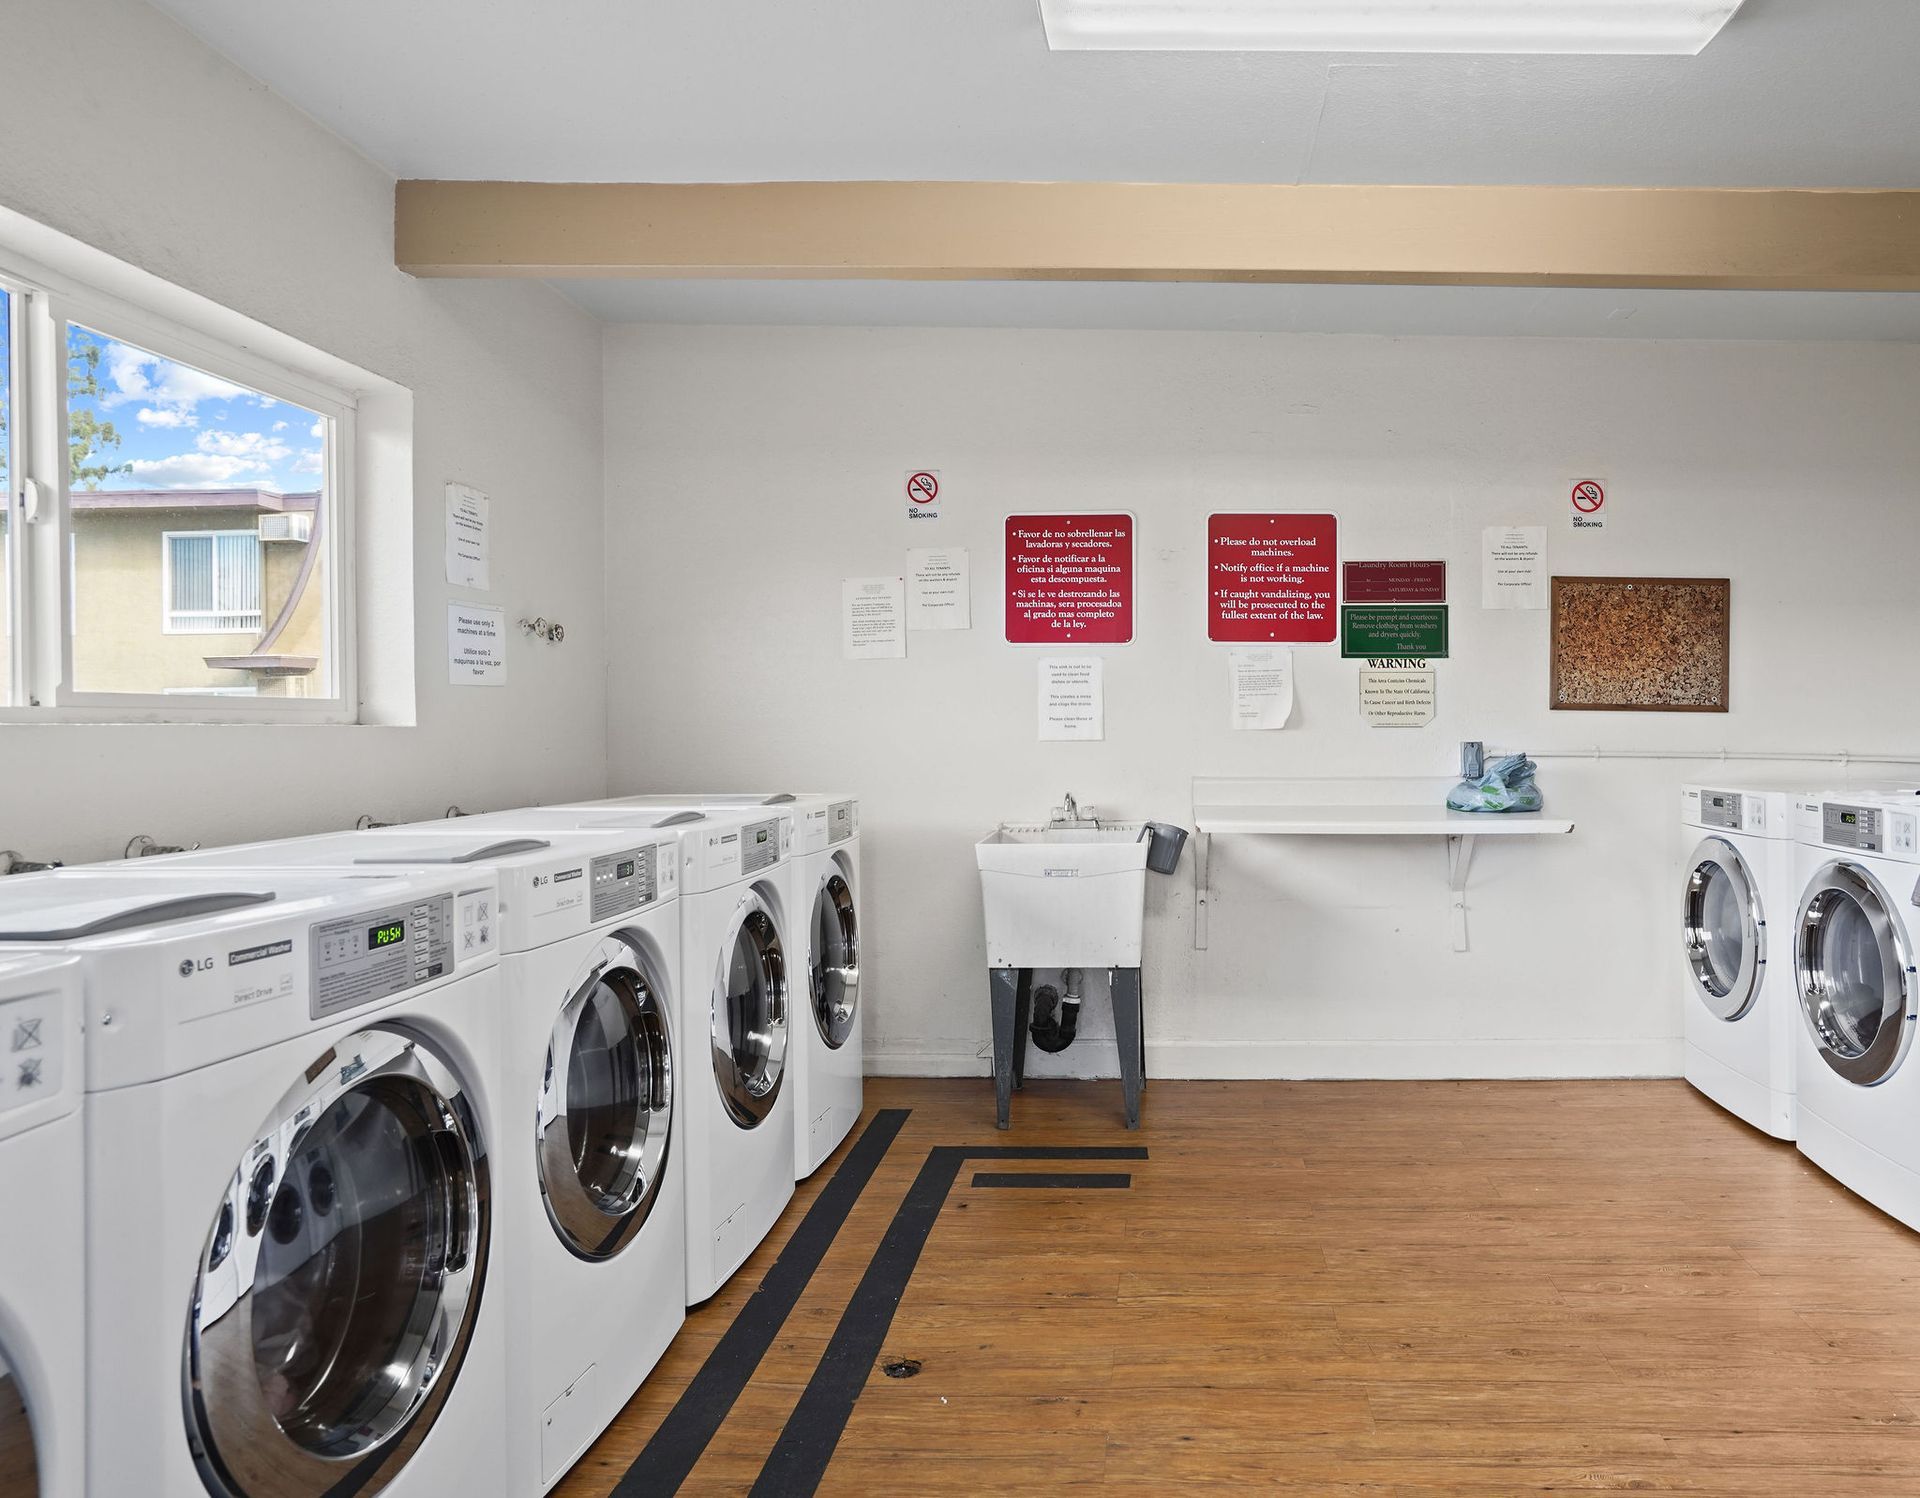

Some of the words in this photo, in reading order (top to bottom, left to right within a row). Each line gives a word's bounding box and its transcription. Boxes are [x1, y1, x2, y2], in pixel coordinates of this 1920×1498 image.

[1018, 530, 1040, 538] Favor
[1115, 529, 1125, 537] las
[1026, 540, 1063, 548] lavadoras
[1072, 540, 1112, 548] secadores.
[1220, 537, 1247, 545] Please
[1249, 537, 1260, 545] do
[1280, 537, 1316, 546] overload
[1251, 548, 1294, 556] machines.
[1055, 554, 1089, 562] notificar
[1098, 554, 1105, 562] la
[1017, 564, 1045, 573] oficina
[1056, 564, 1082, 574] alguna
[1085, 565, 1120, 574] maquina
[1220, 563, 1248, 573] Notify
[1250, 563, 1274, 572] office
[1277, 563, 1283, 572] if
[1293, 564, 1329, 572] machine
[1048, 575, 1107, 584] descompuesta.
[1266, 574, 1304, 584] working.
[1058, 590, 1107, 598] destrozando
[1110, 589, 1120, 597] las
[1221, 589, 1228, 598] If
[1230, 589, 1258, 600] caught
[1261, 590, 1312, 600] vandalizing,
[1220, 600, 1236, 608] will
[1251, 600, 1297, 610] prosecuted
[1312, 600, 1325, 609] the
[1033, 610, 1056, 619] grado
[1076, 610, 1114, 619] completo
[1222, 610, 1248, 619] fullest
[1279, 611, 1288, 619] of
[1291, 611, 1304, 619] the
[1307, 611, 1323, 619] law.
[481, 619, 490, 628] only
[1064, 620, 1071, 628] la
[1073, 620, 1086, 629] ley.
[1376, 622, 1399, 631] clothing
[1368, 658, 1426, 668] WARNING
[378, 927, 400, 944] PUSH
[231, 947, 267, 963] Commercial
[268, 944, 290, 954] Washer
[197, 957, 213, 971] LG
[234, 991, 255, 1003] Direct
[256, 988, 272, 998] Drive
